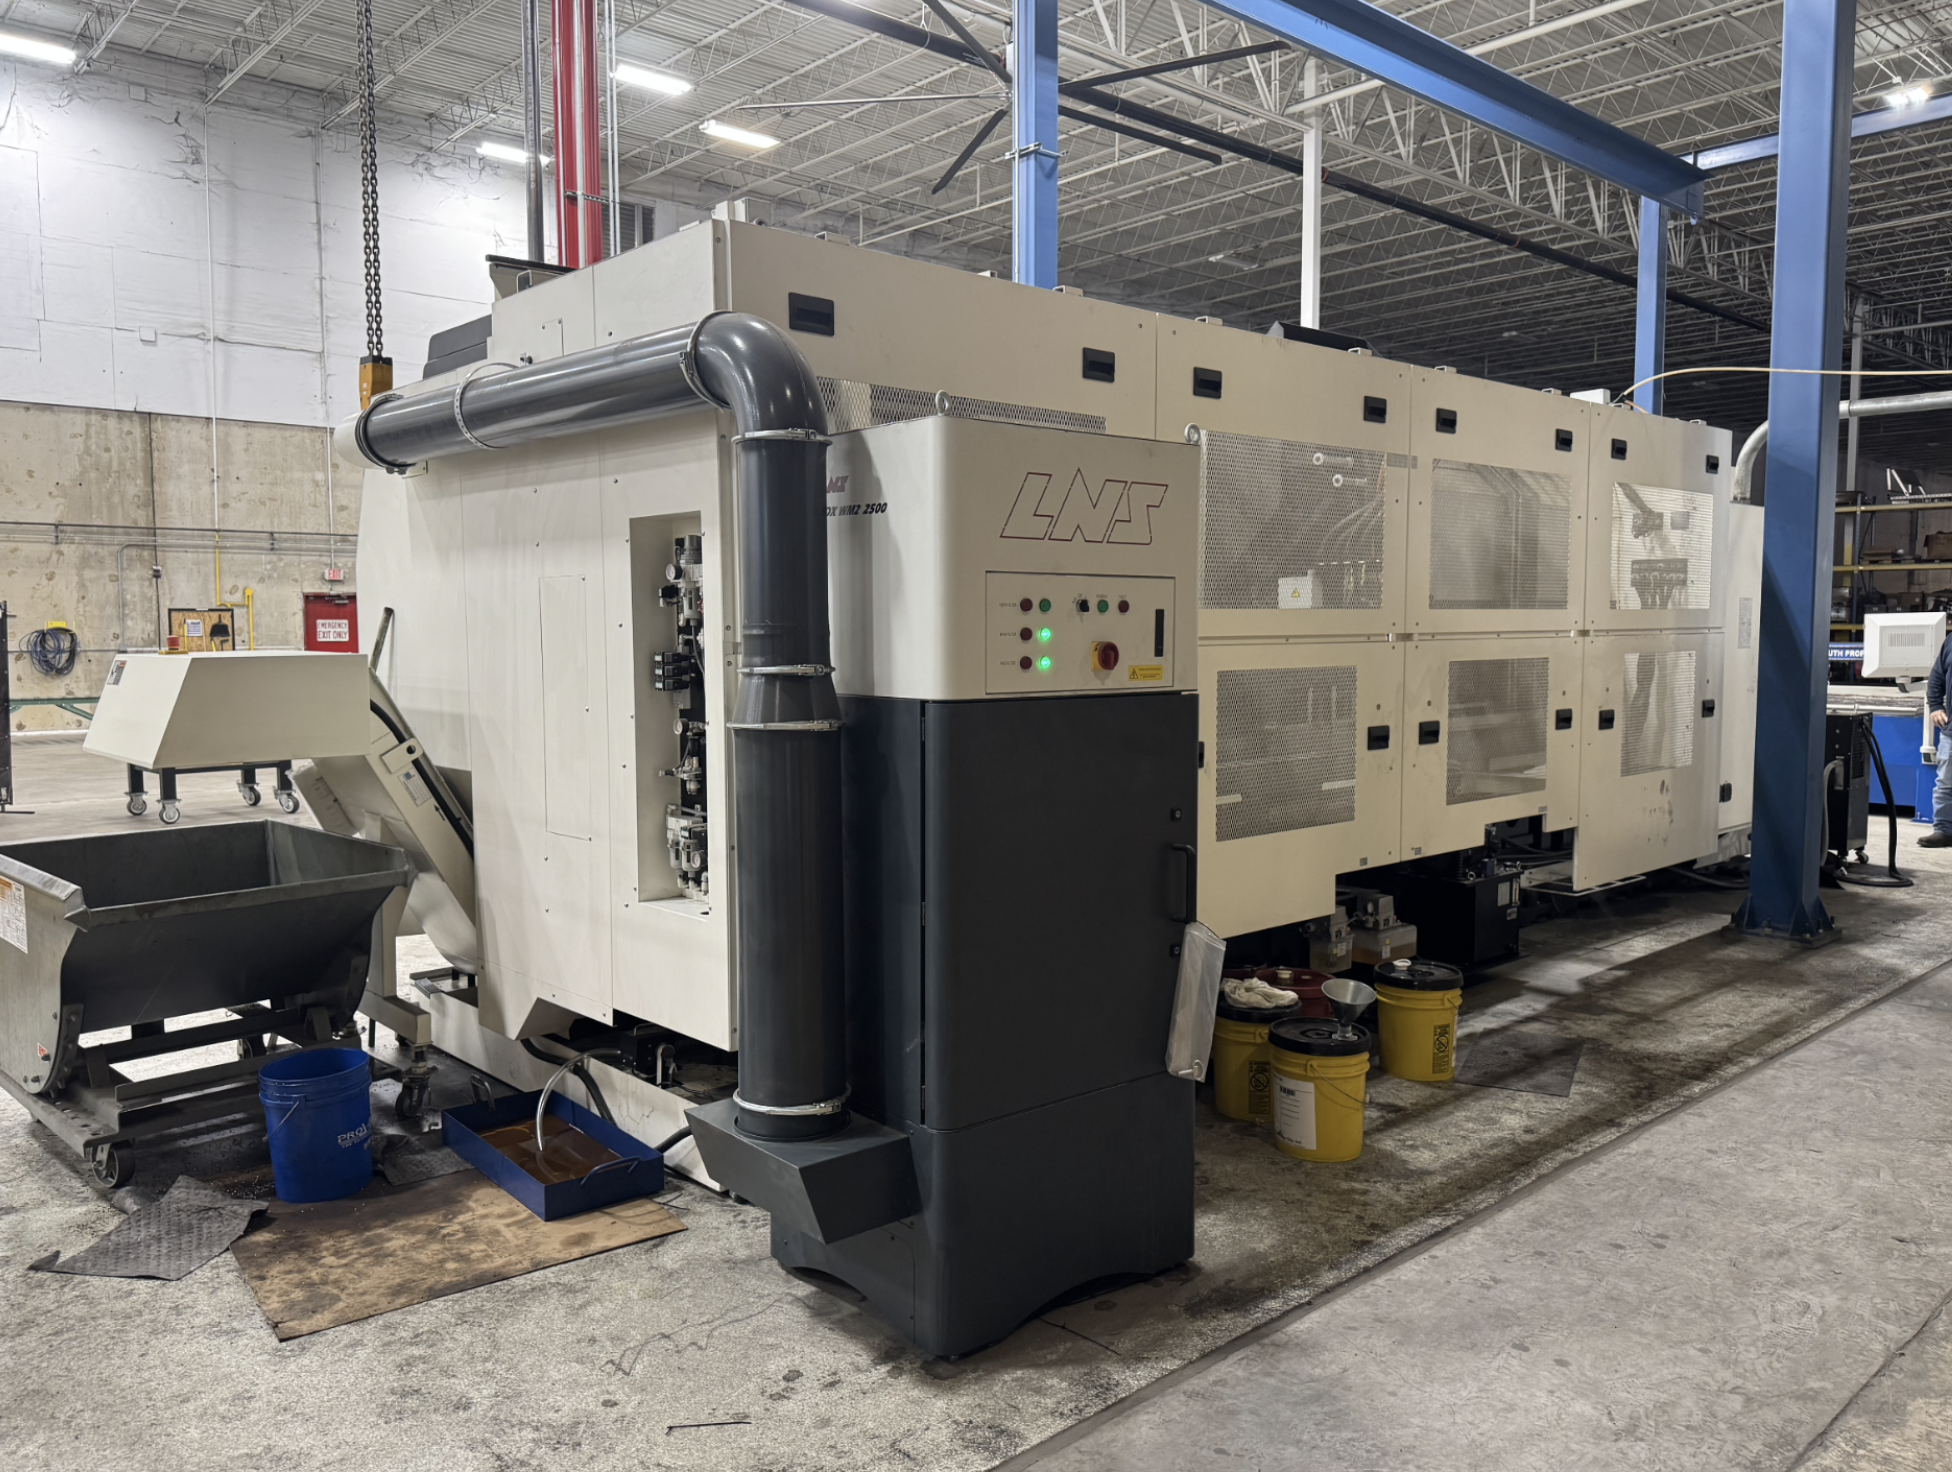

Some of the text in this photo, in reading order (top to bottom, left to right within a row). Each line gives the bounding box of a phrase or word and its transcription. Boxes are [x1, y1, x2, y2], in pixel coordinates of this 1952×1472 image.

[838, 504, 862, 517] WM2
[862, 502, 888, 515] 2500
[999, 467, 1169, 546] LNS
[317, 621, 348, 630] EMERGENCY
[318, 630, 348, 640] EXIT ONLY
